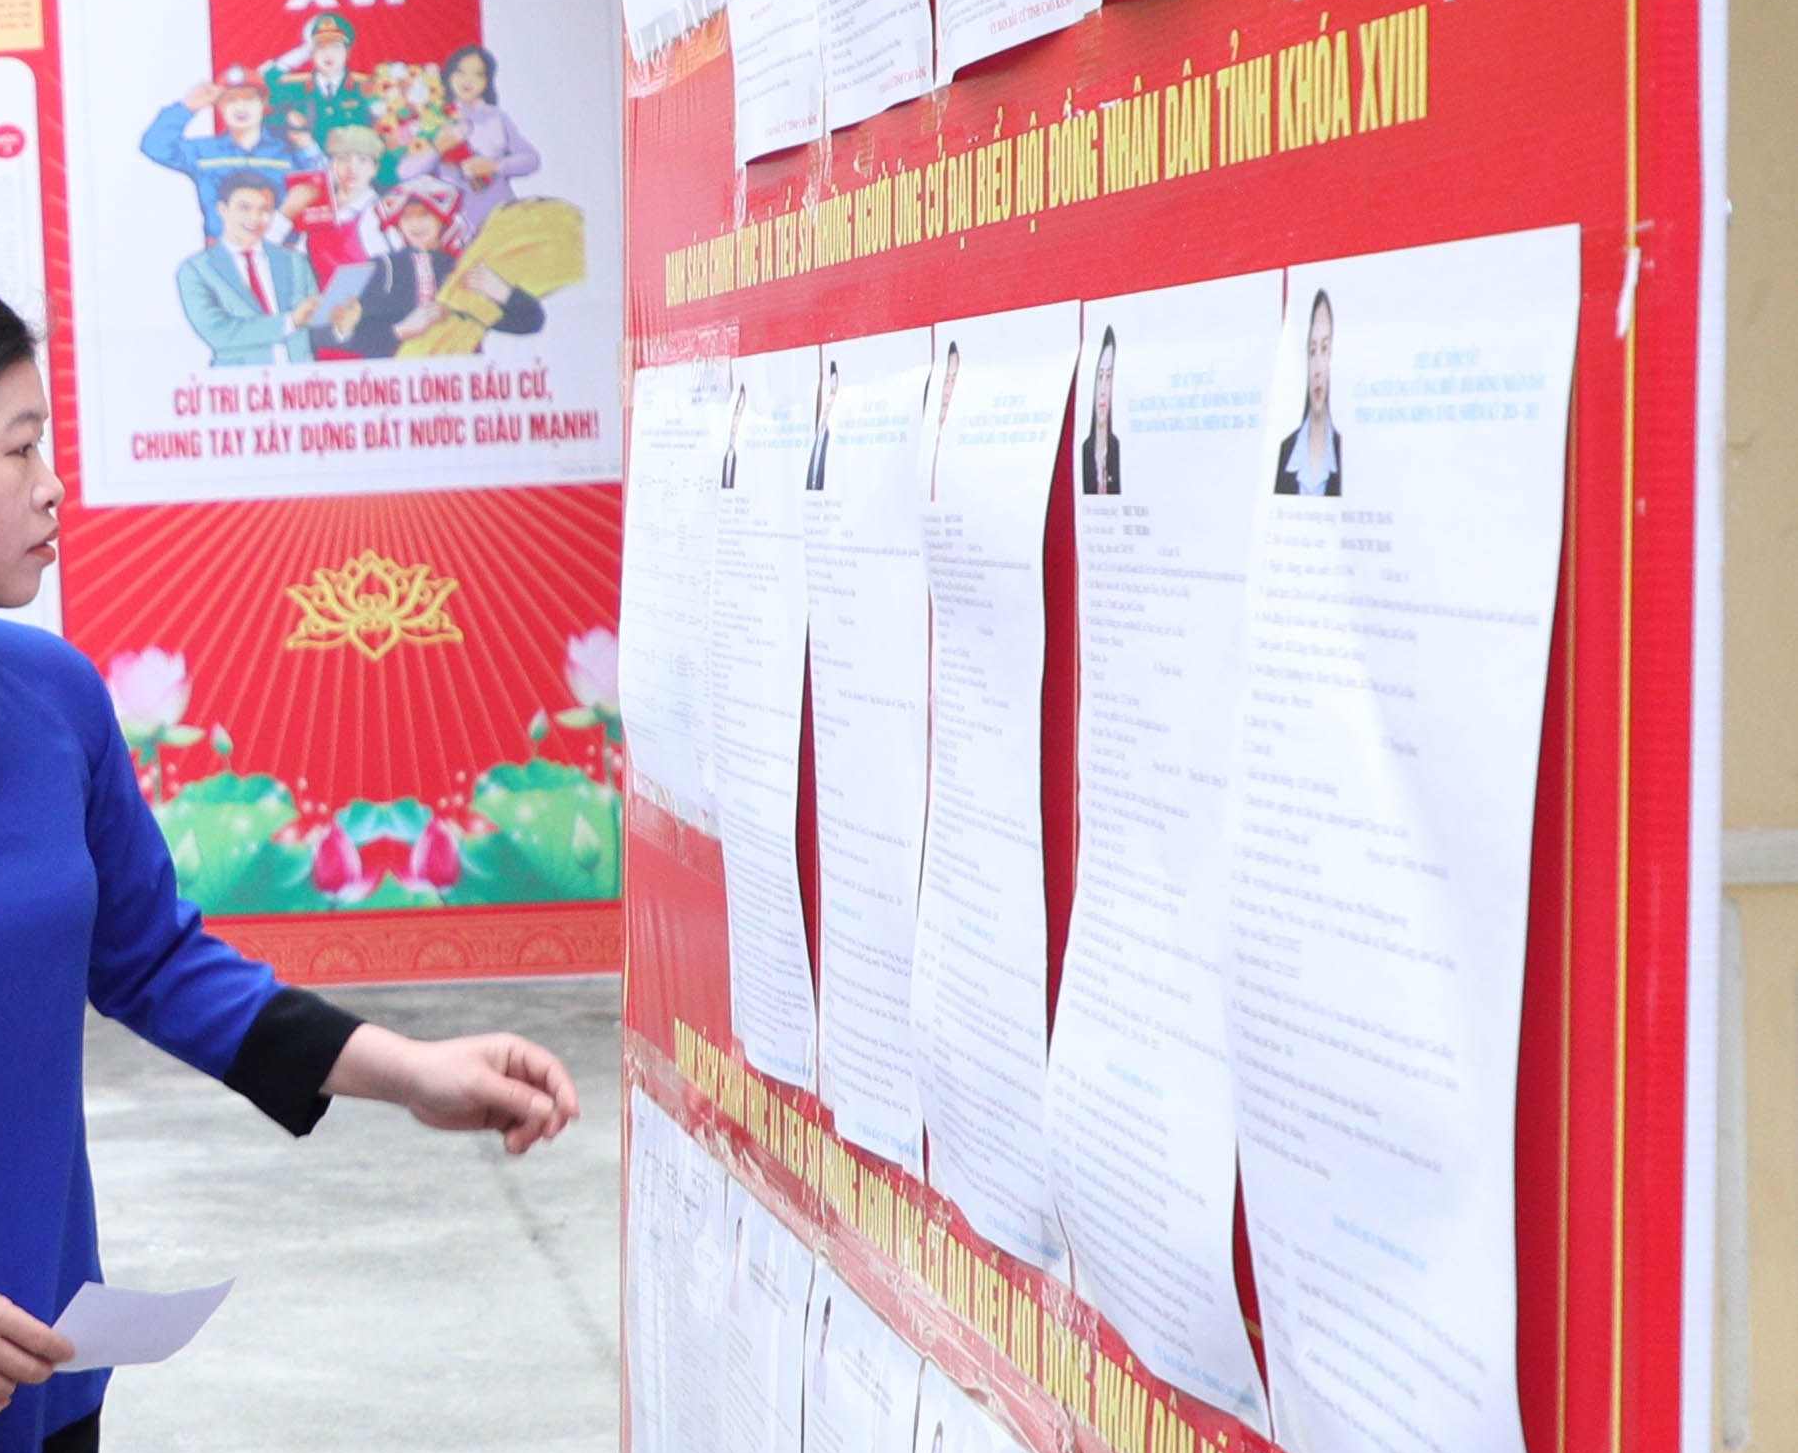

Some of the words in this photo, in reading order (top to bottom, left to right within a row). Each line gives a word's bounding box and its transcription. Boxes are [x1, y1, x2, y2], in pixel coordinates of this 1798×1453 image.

[666, 248, 686, 308] DANH
[687, 232, 708, 303] SÁCH
[709, 223, 735, 296] CHÍNH
[737, 212, 759, 290] THỨC
[760, 206, 773, 283] VÀ
[775, 186, 797, 280] TIỂU
[815, 184, 852, 270] NHỮNG
[855, 161, 891, 259] NGƯỜI
[894, 158, 921, 248] ỨNG
[925, 134, 946, 240] CỬ
[948, 151, 973, 250] ĐẠI
[976, 106, 1012, 227] BIỂU
[1016, 111, 1044, 233] HỘI
[1049, 87, 1098, 209] ĐỒNG
[1103, 75, 1160, 195] NHÂN
[1165, 58, 1212, 180] DÂN
[1216, 29, 1271, 168] TỈNH
[1278, 11, 1352, 153] KHÓA
[1358, 4, 1428, 134] XVIII
[131, 429, 201, 460] CHUNG
[210, 427, 244, 456] TAY
[253, 419, 291, 455] XÂY
[300, 420, 357, 460] DỰNG
[364, 410, 402, 449] ĐẤT
[410, 407, 466, 446] NƯỚC
[475, 407, 521, 445] GIÀU
[530, 409, 600, 449] MẠNH!
[174, 372, 202, 416] CỬ
[208, 385, 239, 414] TRI
[247, 369, 275, 413] CẢ
[281, 371, 337, 410] NƯỚC
[344, 369, 401, 408] ĐỒNG
[409, 366, 463, 405] LÒNG
[471, 358, 512, 401] BẦU
[519, 356, 553, 401] CỬ,
[858, 1163, 893, 1261] NGƯỜI
[947, 1233, 972, 1338] ĐẠI
[974, 1250, 1008, 1358] BIỂU
[1011, 1277, 1038, 1398] HỘI
